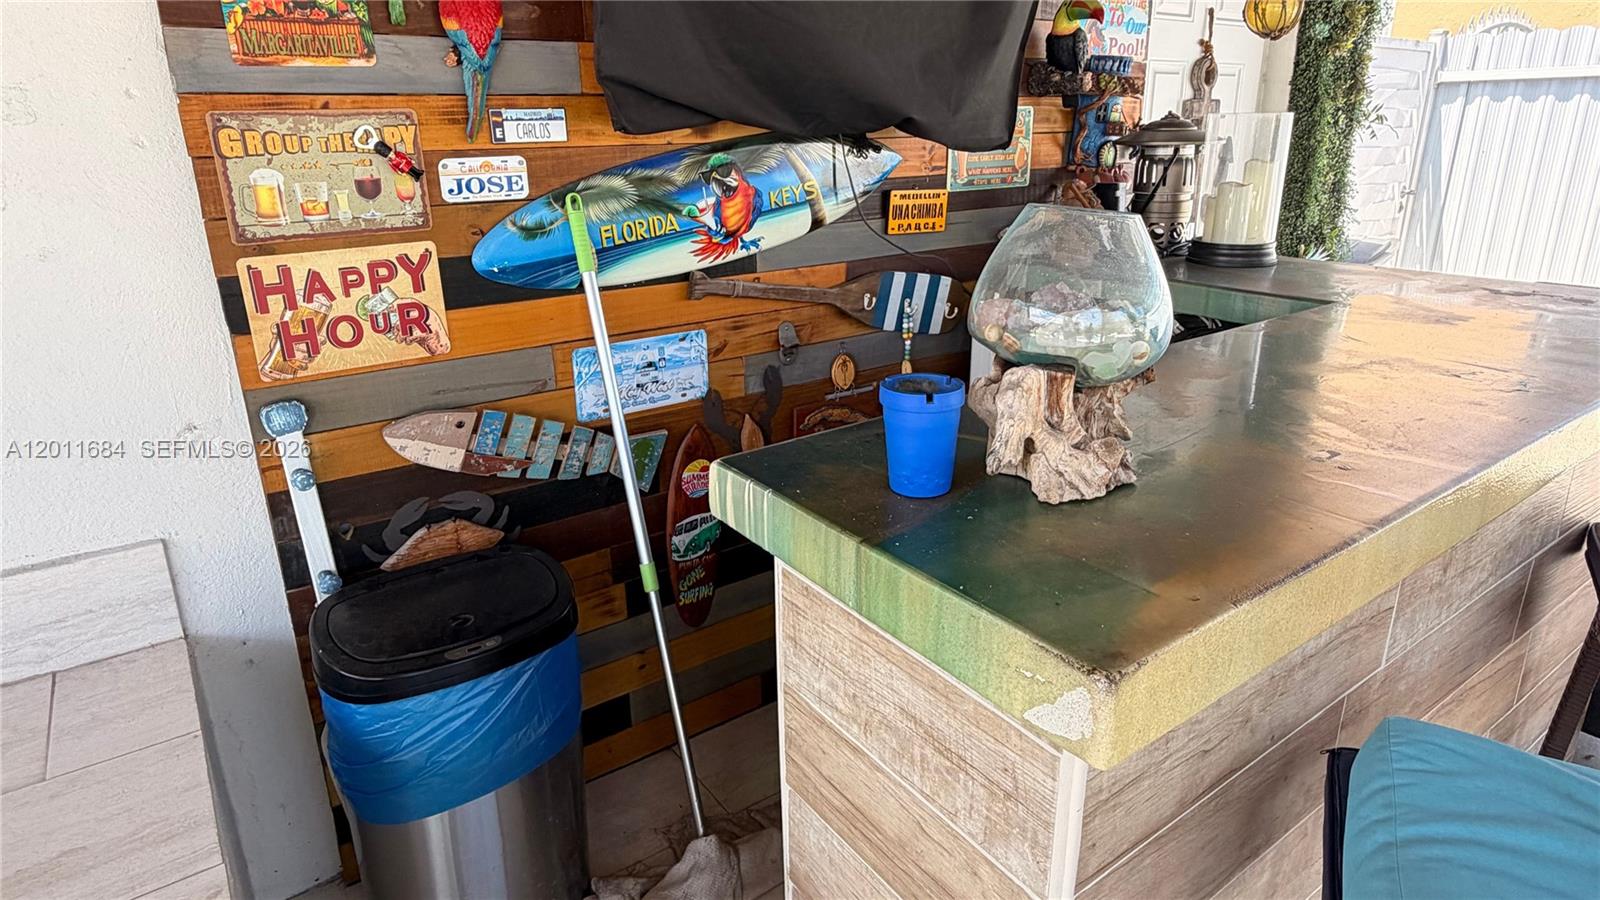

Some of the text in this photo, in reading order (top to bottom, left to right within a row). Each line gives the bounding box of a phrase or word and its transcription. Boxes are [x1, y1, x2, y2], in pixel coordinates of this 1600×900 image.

[1109, 7, 1124, 27] To
[1126, 17, 1147, 34] Our
[239, 28, 360, 57] MARGARITAVILLE
[1108, 37, 1145, 56] Pool!
[495, 127, 505, 139] E
[516, 122, 551, 139] CARLOS
[216, 125, 313, 159] GROUP
[460, 161, 509, 173] CALIFORNIA
[447, 174, 524, 197] JOSE
[899, 192, 941, 200] MEDELLIN
[600, 181, 818, 247] FLORIDA KEYS
[247, 249, 433, 315] HAPPY
[277, 301, 433, 361] HOUR
[682, 472, 710, 486] SUMME
[680, 565, 705, 591] GONE
[679, 582, 714, 606] SURFING
